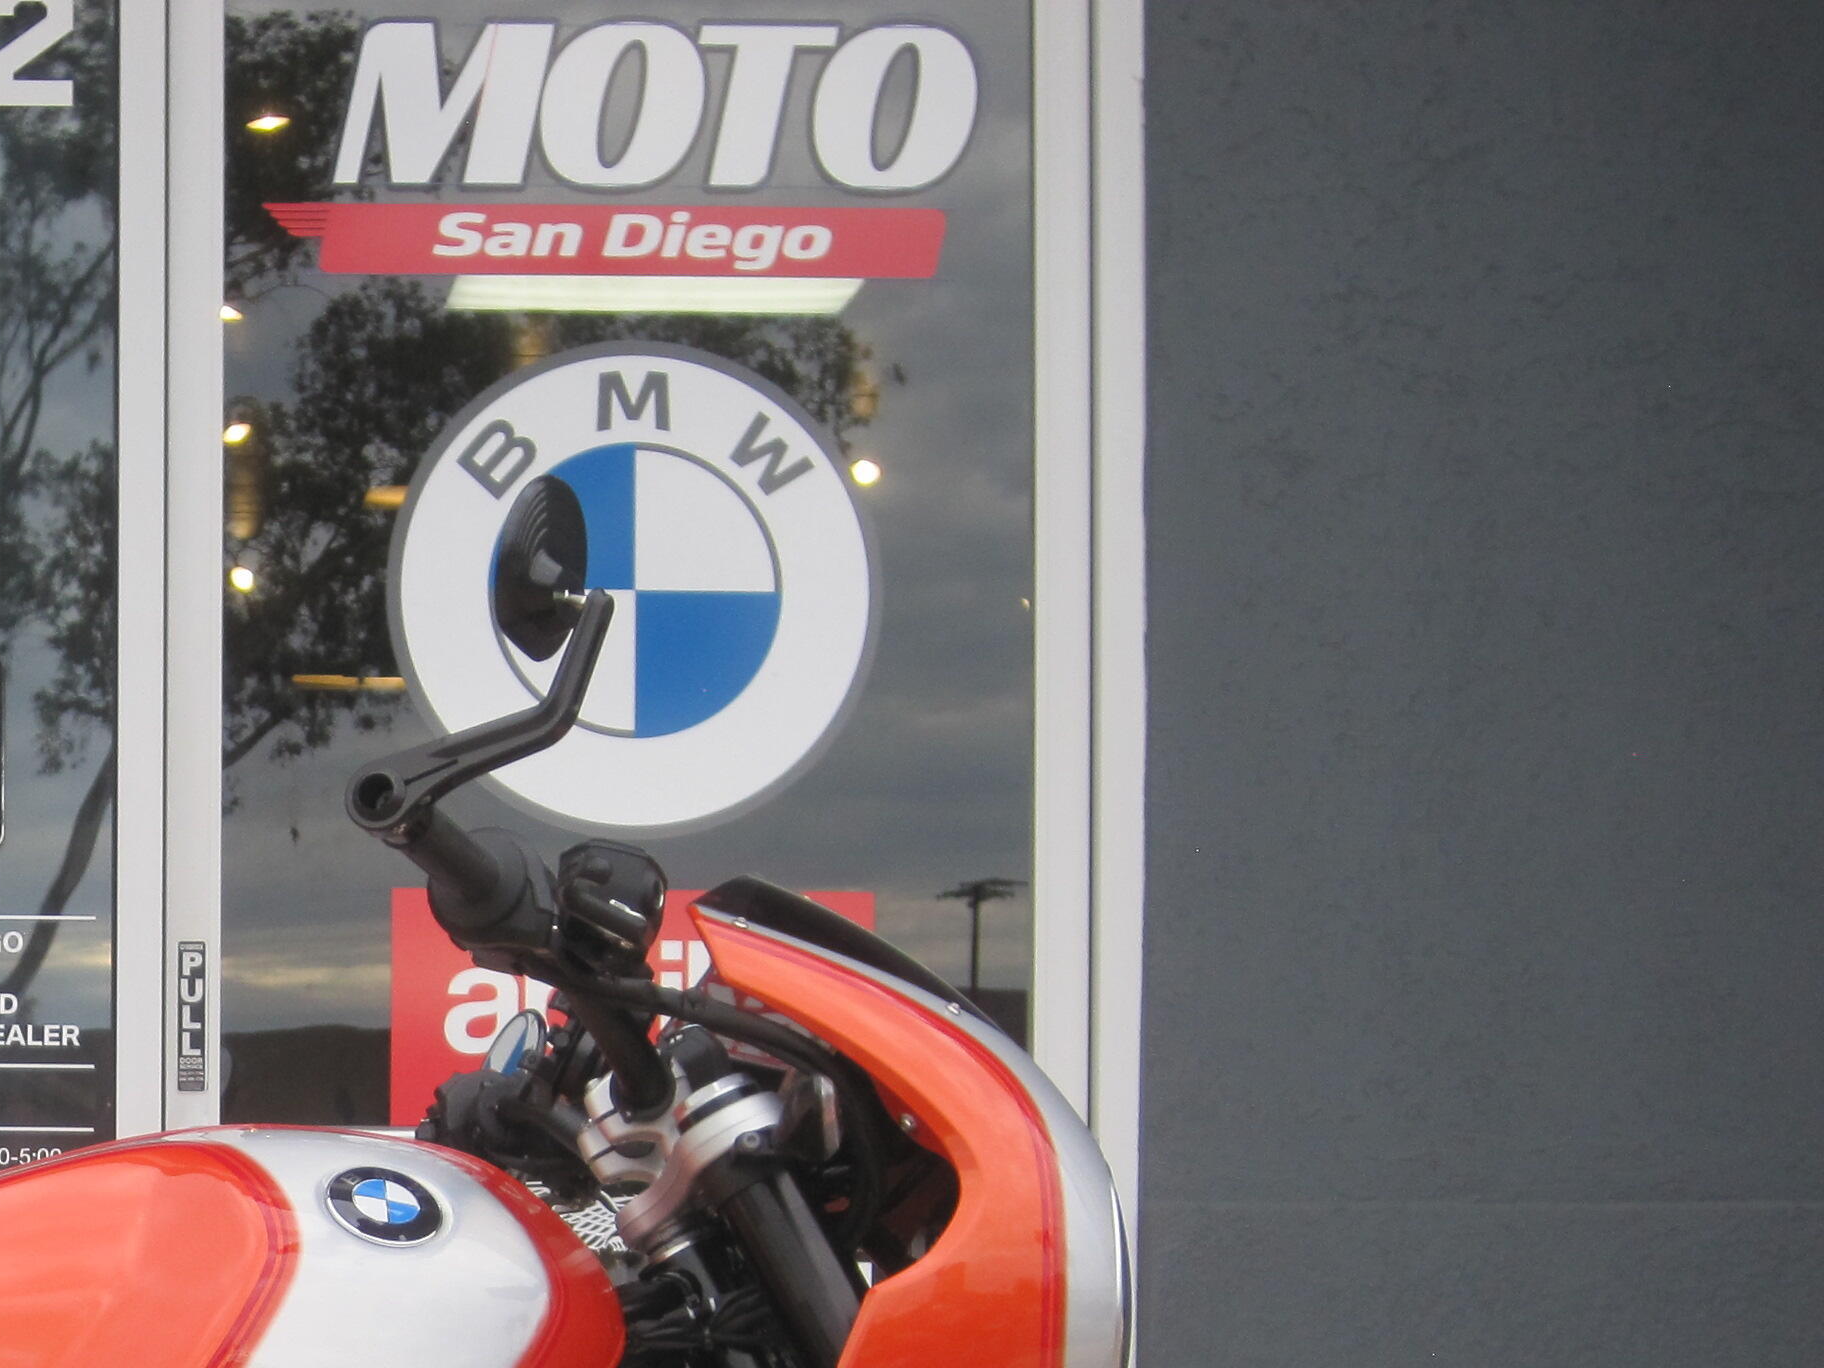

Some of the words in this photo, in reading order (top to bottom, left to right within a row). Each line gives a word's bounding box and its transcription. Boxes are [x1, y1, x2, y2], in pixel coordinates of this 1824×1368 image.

[332, 22, 978, 191] MOTO
[432, 213, 581, 258] San
[602, 212, 832, 271] Diego
[457, 371, 815, 500] BMW
[180, 952, 203, 1055] PULL
